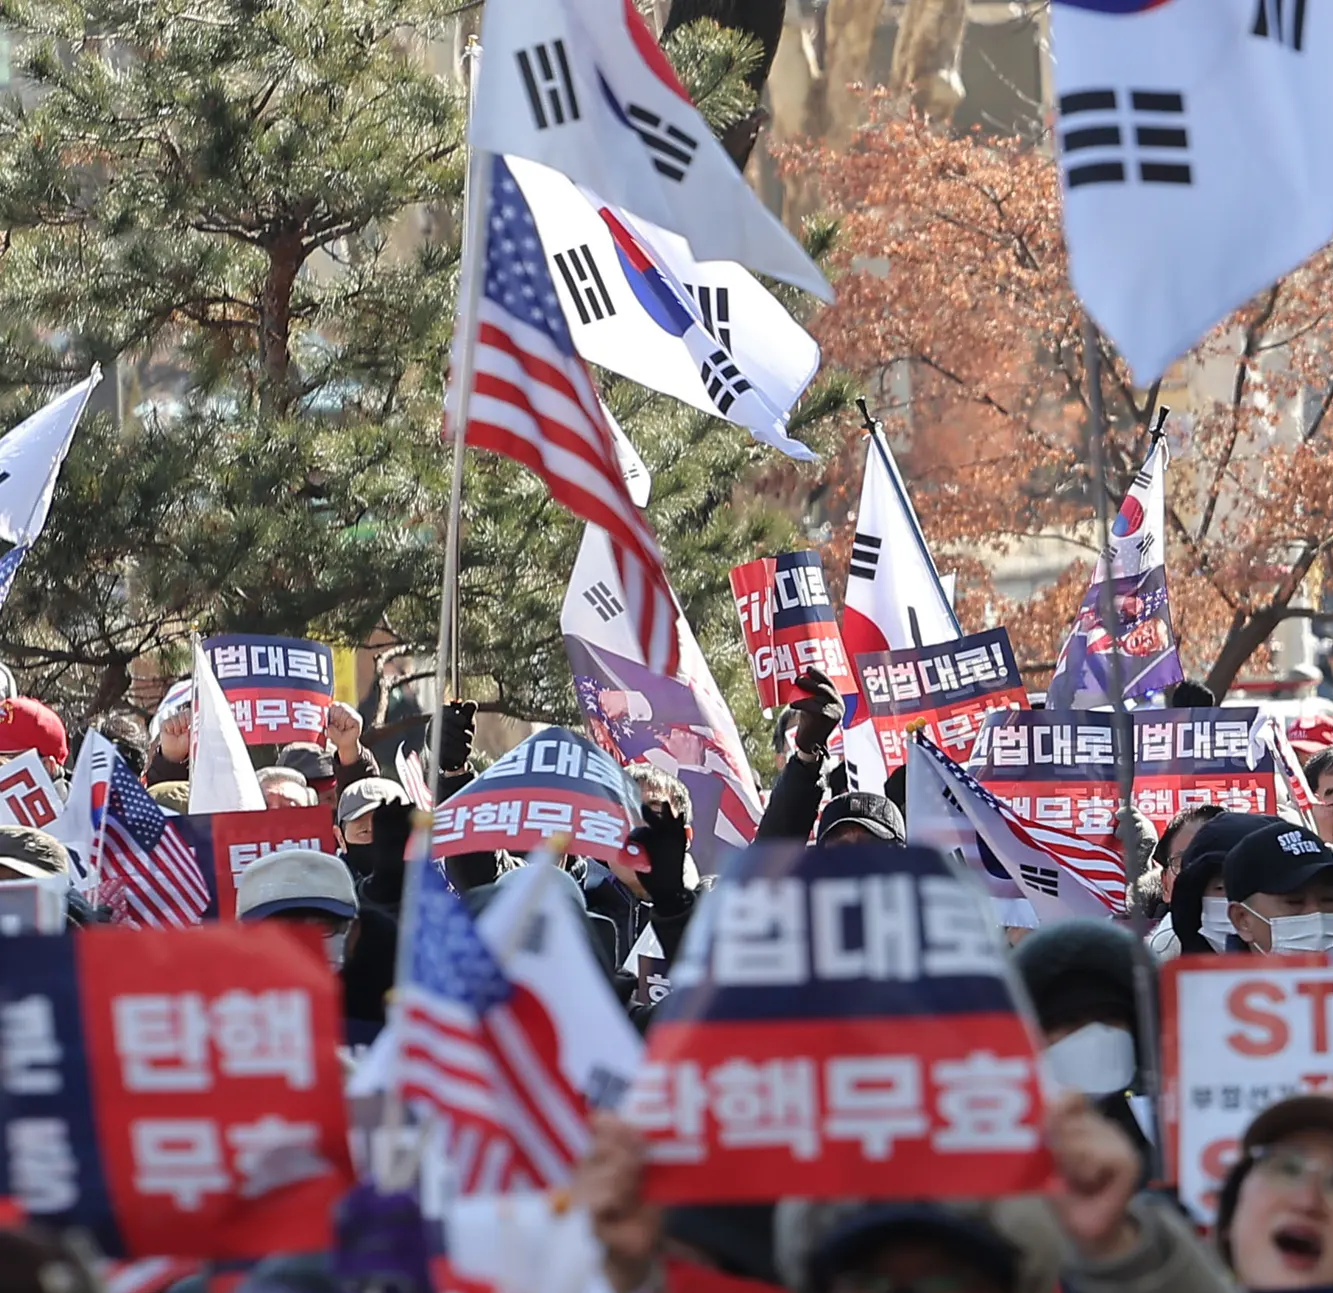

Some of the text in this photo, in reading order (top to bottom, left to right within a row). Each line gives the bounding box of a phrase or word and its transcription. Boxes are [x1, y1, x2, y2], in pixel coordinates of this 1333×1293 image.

[205, 645, 330, 686] 법대로!
[863, 643, 1010, 704] 헌법대로!
[1133, 720, 1250, 763] 법대로
[432, 801, 626, 850] 탄핵무효
[1277, 830, 1303, 847] STOP
[1290, 838, 1322, 856] STEAL
[111, 985, 318, 1093] 탄핵
[622, 1050, 1040, 1164] 탄핵무효
